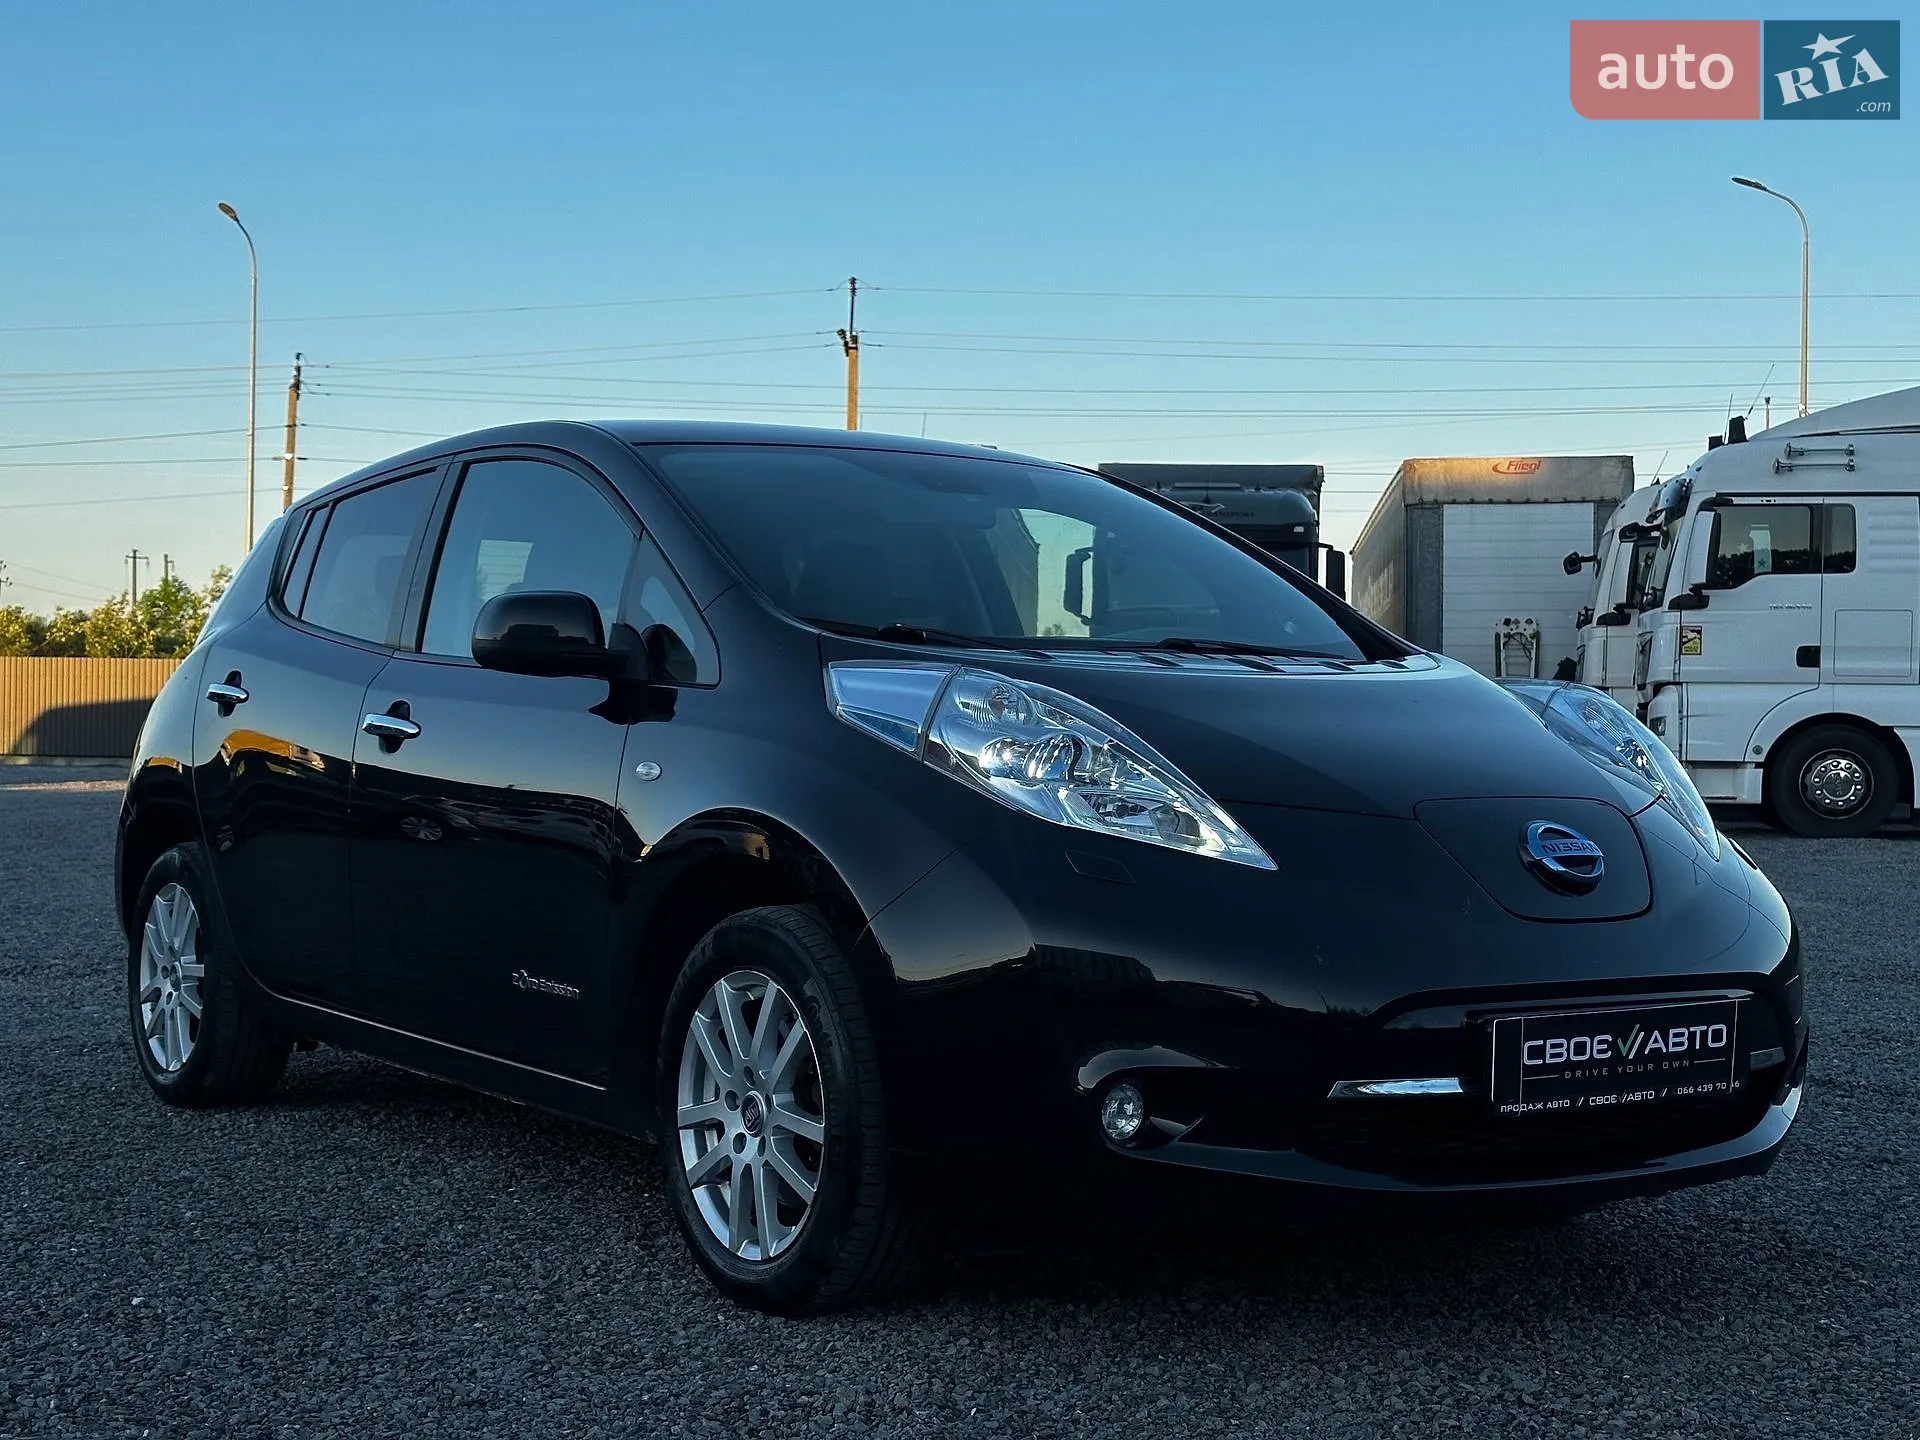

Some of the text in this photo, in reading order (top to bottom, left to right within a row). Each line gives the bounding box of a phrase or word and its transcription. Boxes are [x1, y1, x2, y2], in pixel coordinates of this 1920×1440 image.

[1507, 460, 1542, 472] Fliegl
[1541, 841, 1597, 853] NISSAN
[1564, 1059, 1690, 1079] DRIVE YOUR OWN
[1500, 1101, 1543, 1113] ПРОДАЖ
[1546, 1099, 1571, 1109] АВТО
[1677, 1085, 1694, 1095] 066
[1697, 1083, 1713, 1092] 439
[1715, 1082, 1727, 1090] 70
